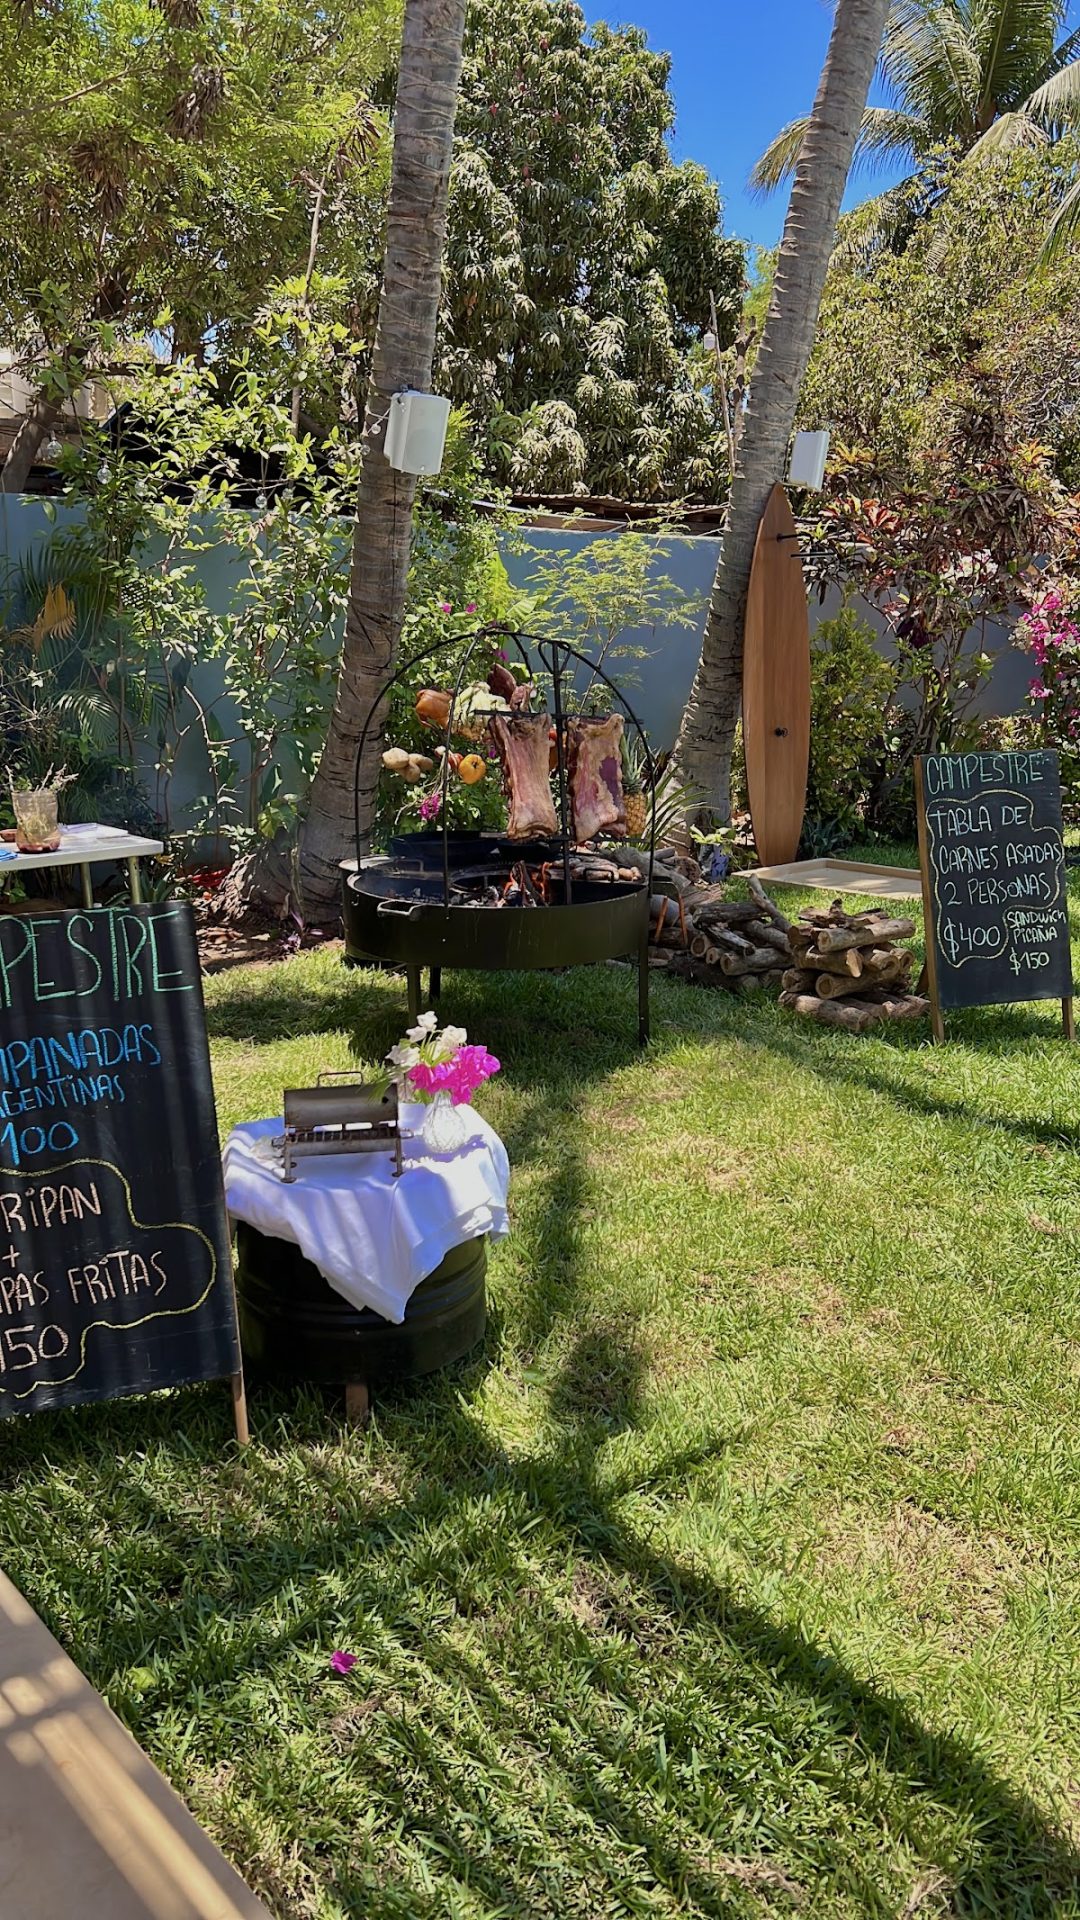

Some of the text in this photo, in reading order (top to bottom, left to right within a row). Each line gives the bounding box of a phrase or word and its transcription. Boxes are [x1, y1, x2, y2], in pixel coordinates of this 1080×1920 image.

[926, 753, 1044, 795] CAMPESTRE
[928, 805, 1027, 838] TABLA DE
[939, 842, 1062, 875] CARNES ASADAS
[944, 872, 1051, 906] 2 PERSONAS
[0, 906, 194, 1007] PESTRE
[943, 917, 1001, 961] $400
[1009, 947, 1050, 976] $150
[0, 1270, 50, 1315] PAS
